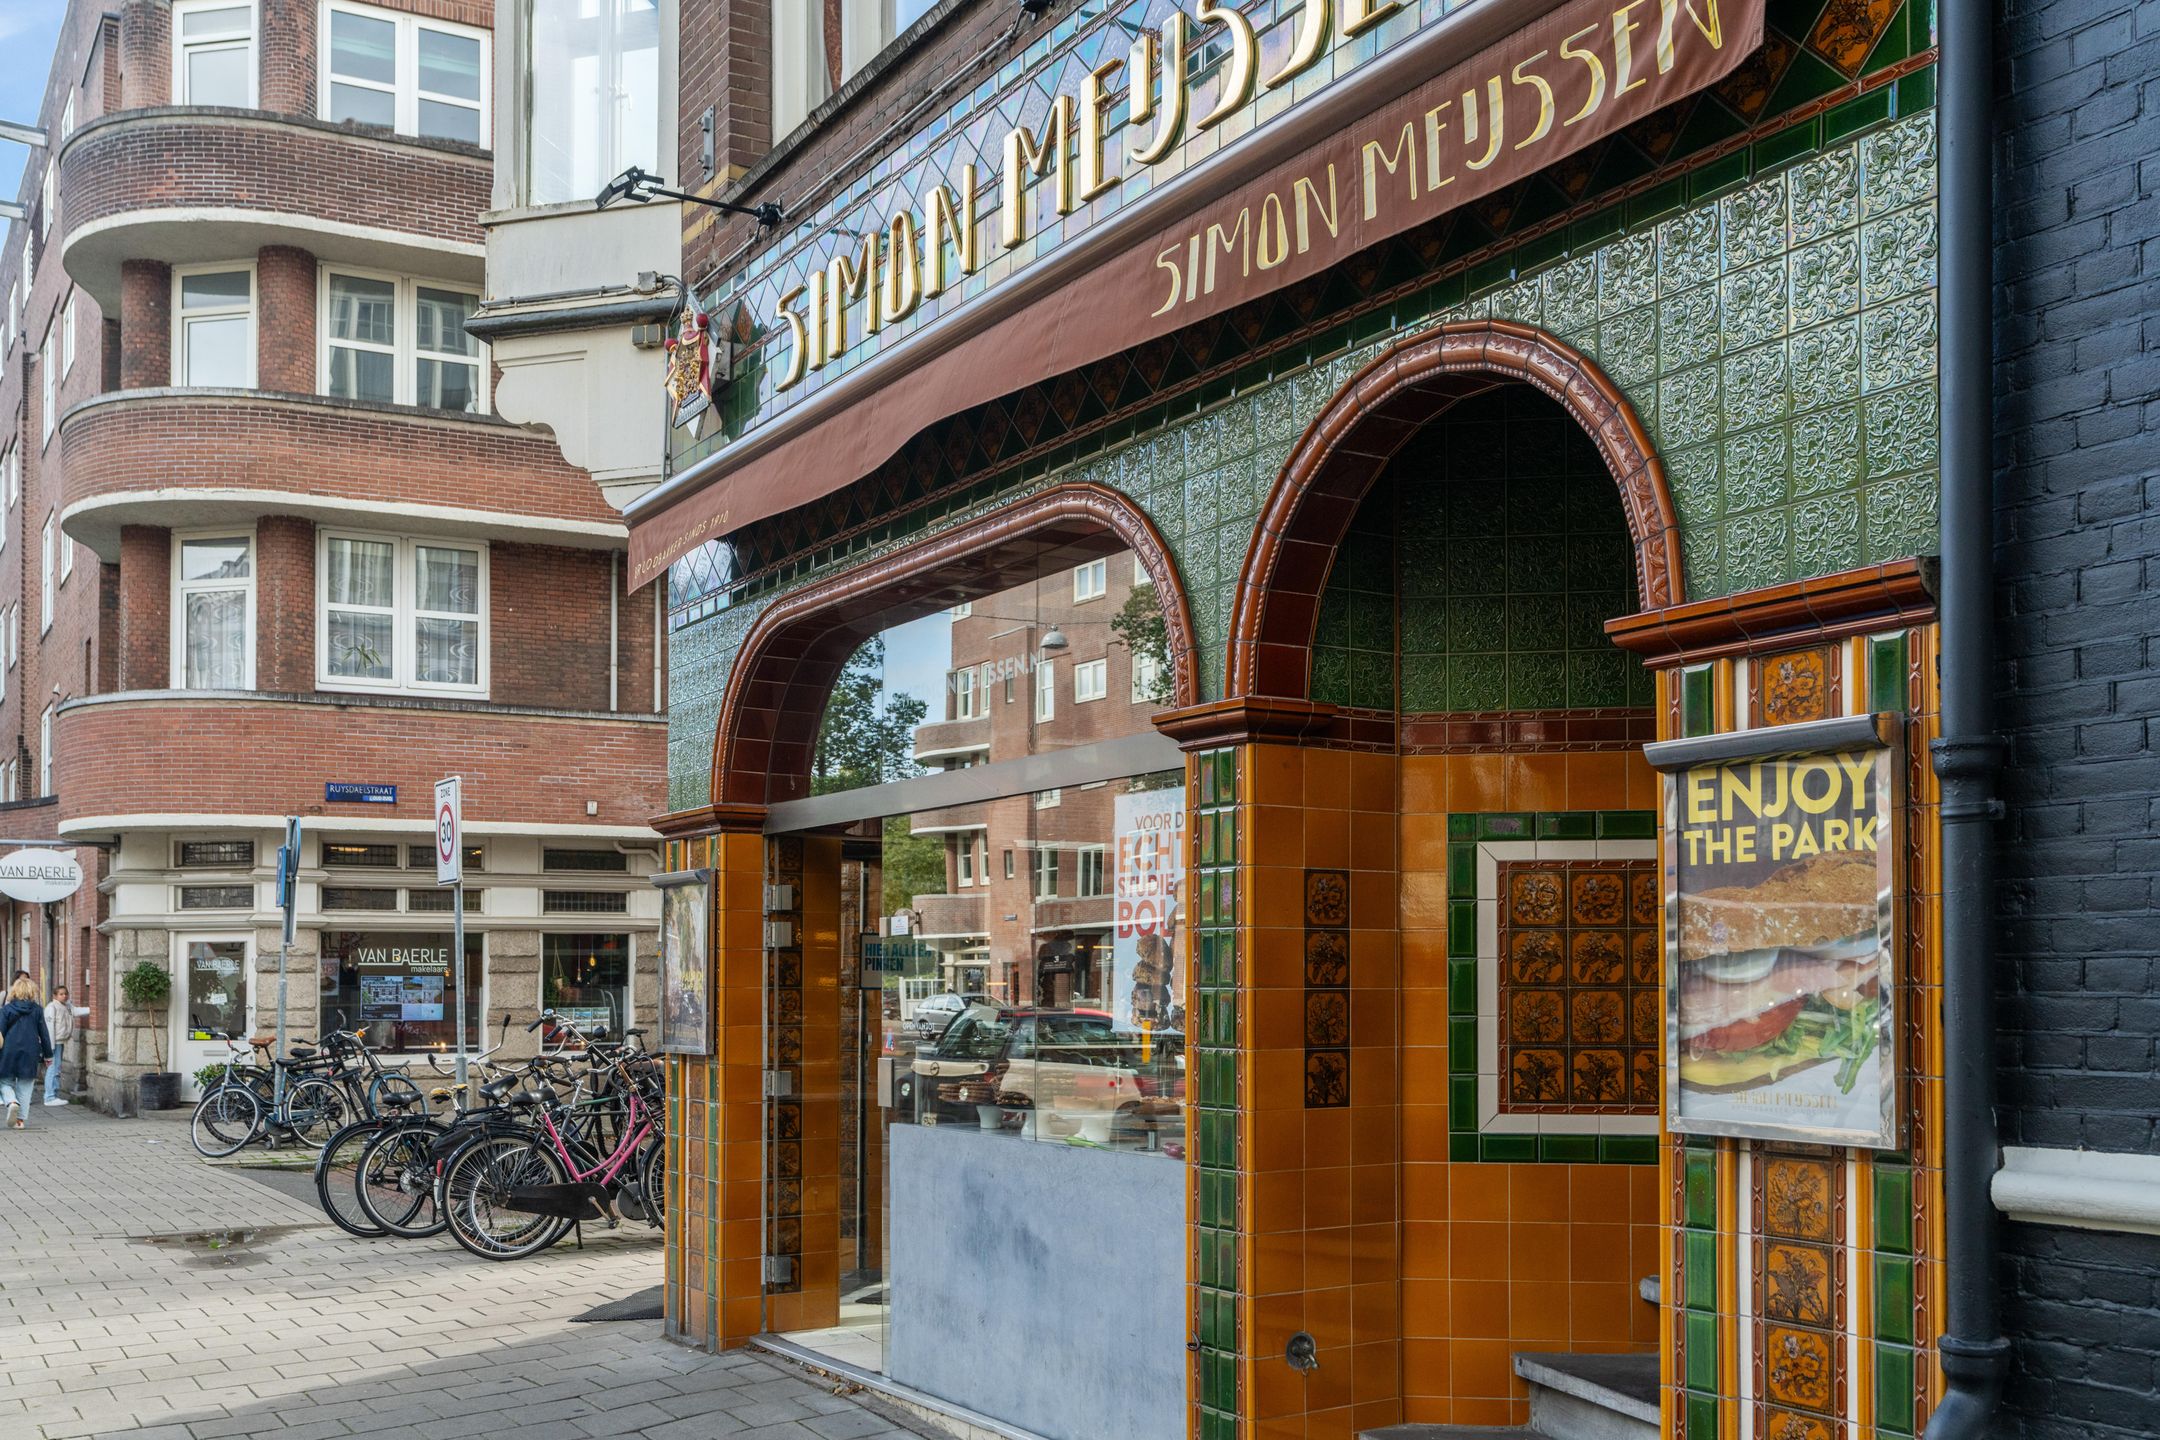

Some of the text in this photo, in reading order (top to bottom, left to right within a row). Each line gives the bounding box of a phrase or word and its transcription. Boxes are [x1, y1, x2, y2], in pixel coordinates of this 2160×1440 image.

[1151, 0, 1722, 317] SIMON MEIJSSEN
[775, 163, 978, 392] SIMON
[682, 520, 707, 545] SINDS
[710, 510, 729, 529] 1910
[329, 784, 394, 795] RUYSDAELSTRAAT
[440, 787, 451, 798] ZONE
[1687, 751, 1876, 824] ENJOY
[1135, 812, 1172, 832] VOOR
[441, 821, 452, 843] 30
[1683, 816, 1877, 866] THE PARK
[0, 866, 77, 879] VAN BAERLE
[358, 948, 448, 965] VAN BAERLE
[865, 944, 890, 957] HIER
[196, 959, 240, 969] VAN BAERLE
[411, 965, 448, 974] makelaars
[865, 958, 904, 971] PINNEN
